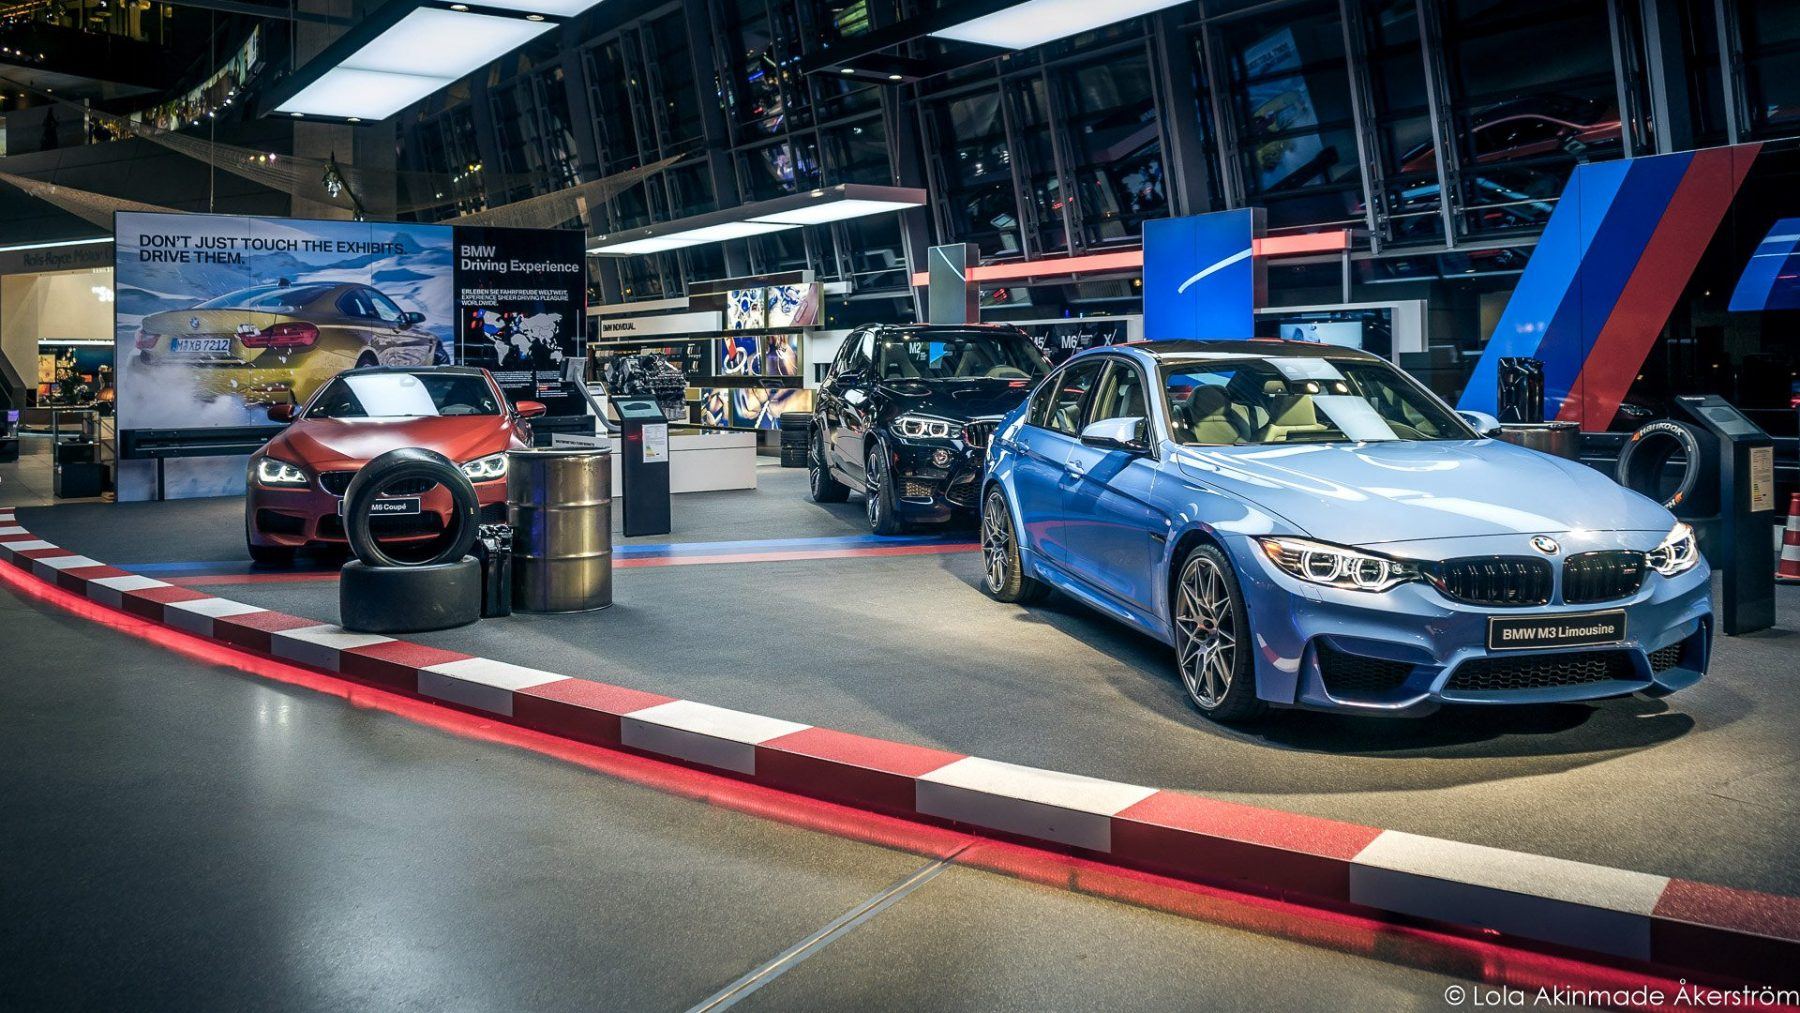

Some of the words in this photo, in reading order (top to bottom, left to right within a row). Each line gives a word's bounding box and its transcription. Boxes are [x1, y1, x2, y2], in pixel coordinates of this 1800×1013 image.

[140, 234, 192, 248] DON'T
[195, 236, 238, 249] JUST
[241, 237, 297, 251] TOUCH
[301, 239, 333, 252] THE
[336, 240, 408, 255] EXHIBITS.
[461, 245, 496, 258] BMW
[140, 249, 190, 263] DRIVE
[194, 250, 245, 265] THEM.
[461, 258, 507, 274] Driving
[510, 259, 580, 274] Experience
[203, 339, 228, 351] 7212
[383, 502, 407, 511] Coupé
[1502, 628, 1536, 641] BMW
[1537, 627, 1556, 639] M3
[1558, 624, 1615, 638] Limousine
